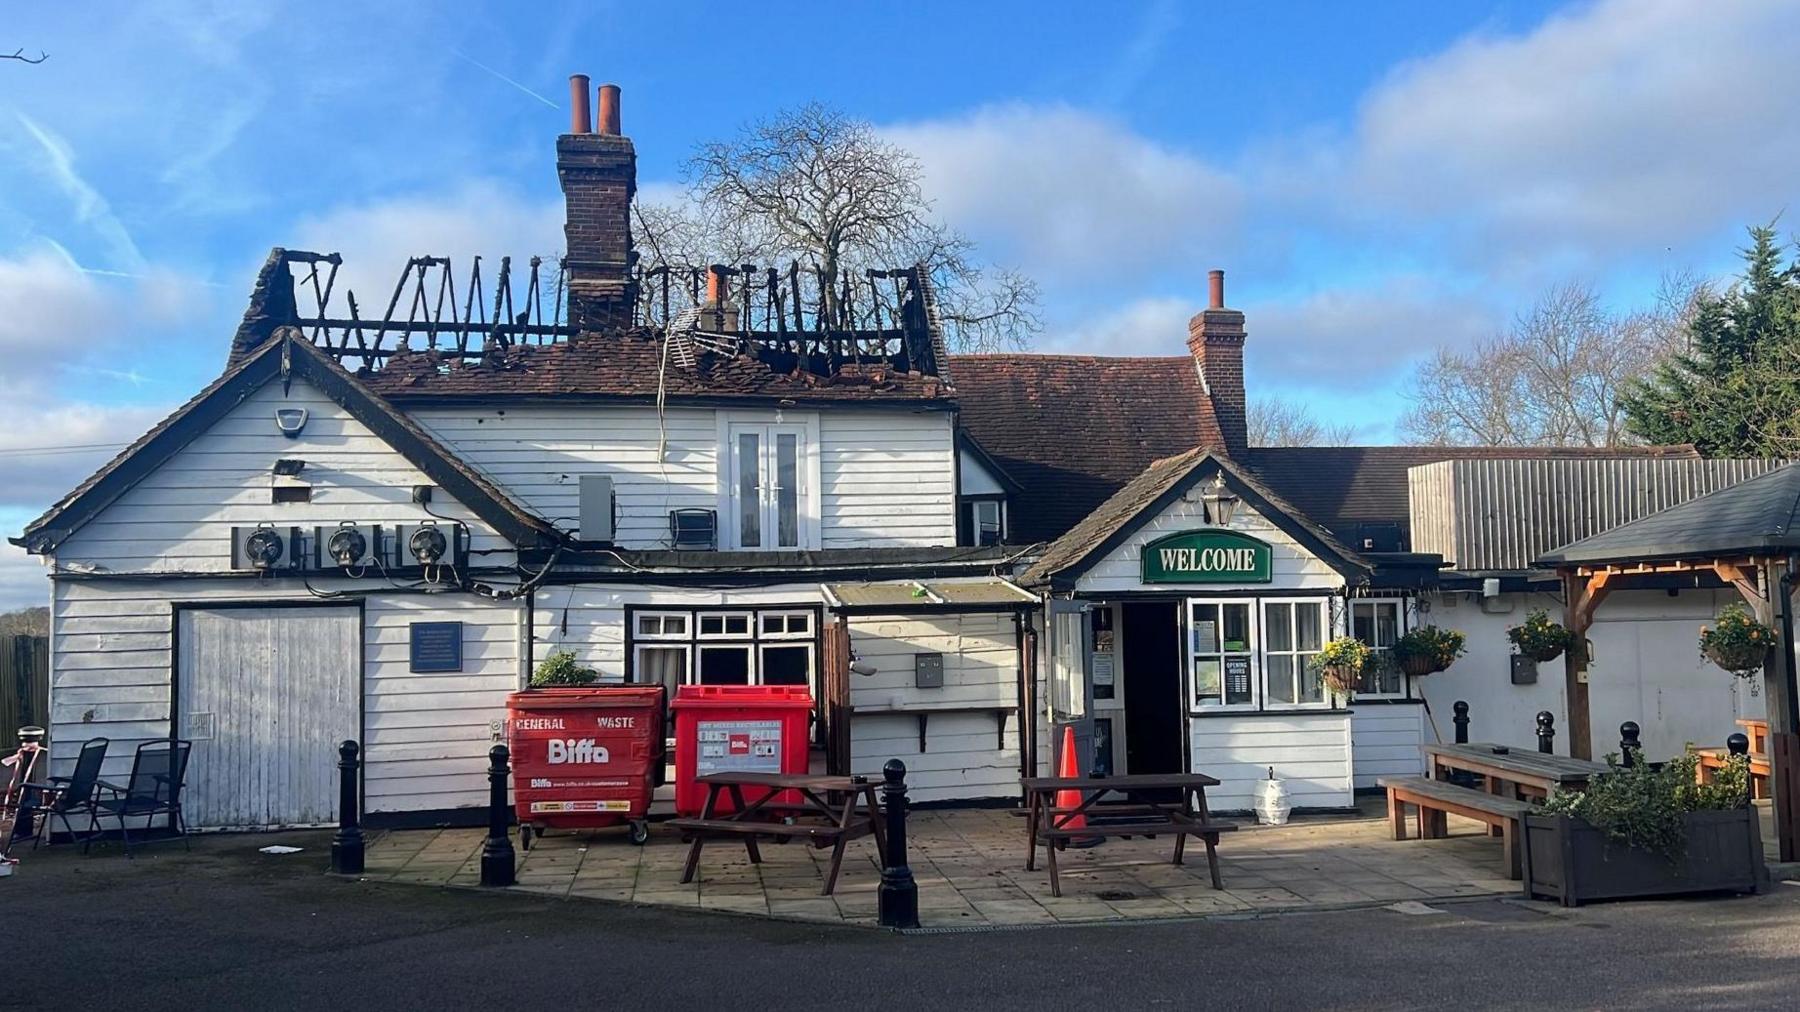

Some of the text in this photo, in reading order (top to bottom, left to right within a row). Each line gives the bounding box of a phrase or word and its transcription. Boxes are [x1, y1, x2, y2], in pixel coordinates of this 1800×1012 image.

[1159, 548, 1255, 571] WELCOME
[516, 717, 635, 730] GENERAL WASTE
[548, 738, 609, 764] Biffa
[531, 779, 552, 788] Biffa
